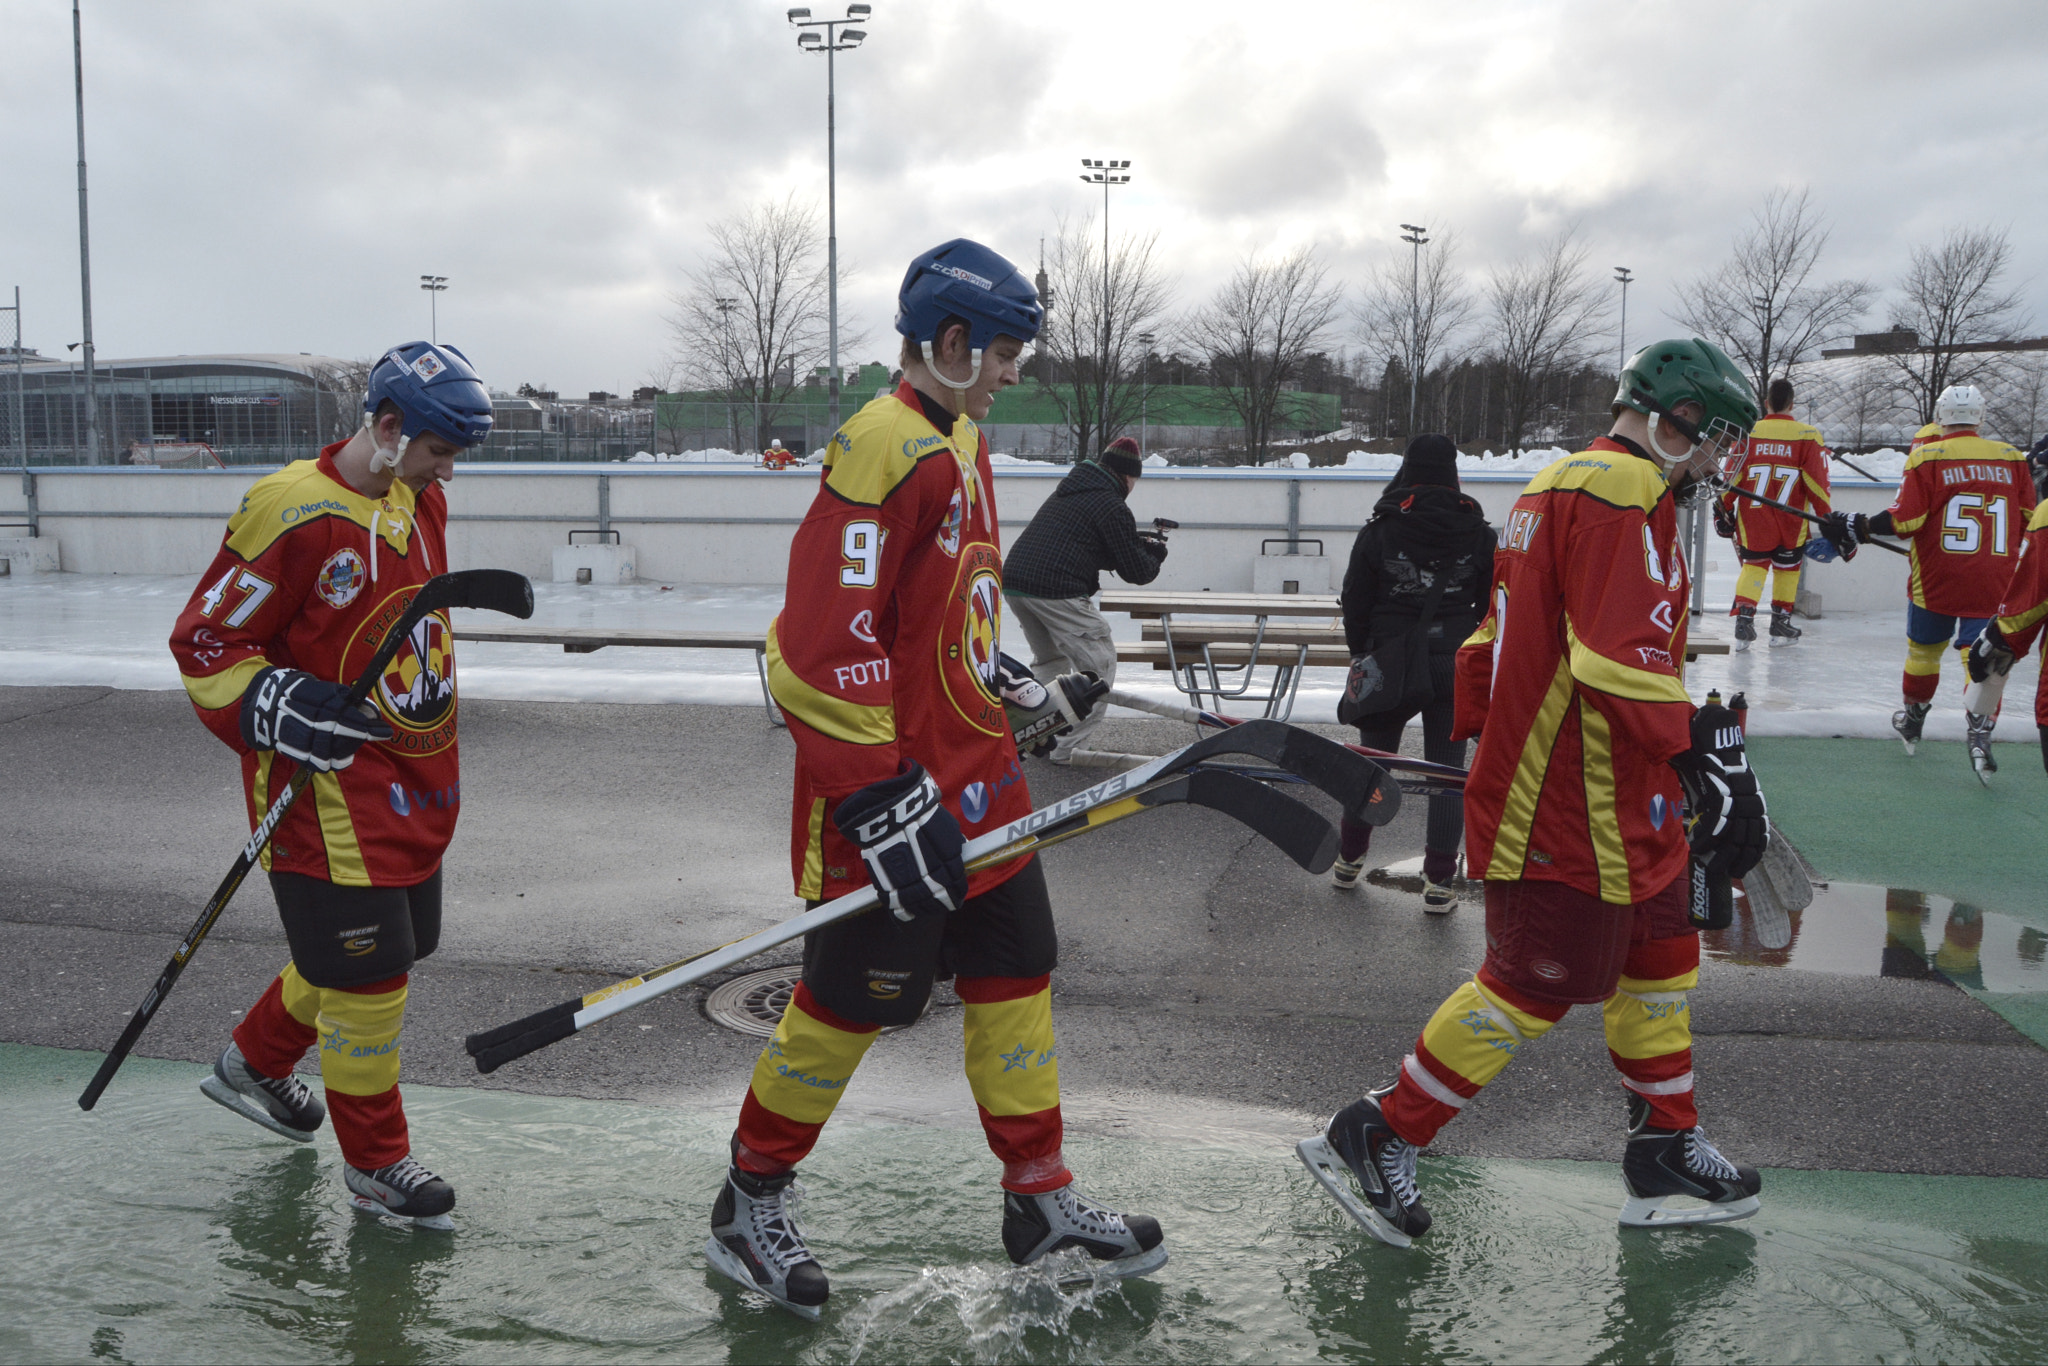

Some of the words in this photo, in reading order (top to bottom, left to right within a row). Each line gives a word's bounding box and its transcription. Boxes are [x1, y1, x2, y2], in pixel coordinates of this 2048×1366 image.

[959, 271, 992, 291] DiPrint
[210, 395, 261, 405] Nessukesus
[1755, 442, 1792, 458] PEURA
[1941, 464, 2013, 485] HILTUNEN
[1747, 463, 1803, 509] 77
[1940, 491, 2009, 556] 51
[840, 519, 889, 589] 9
[200, 564, 276, 630] 47
[363, 593, 413, 648] ETELÄ
[1013, 711, 1057, 744] FAST
[243, 782, 294, 863] BAUER
[855, 776, 941, 843] CCM
[1006, 774, 1128, 843] EASTON
